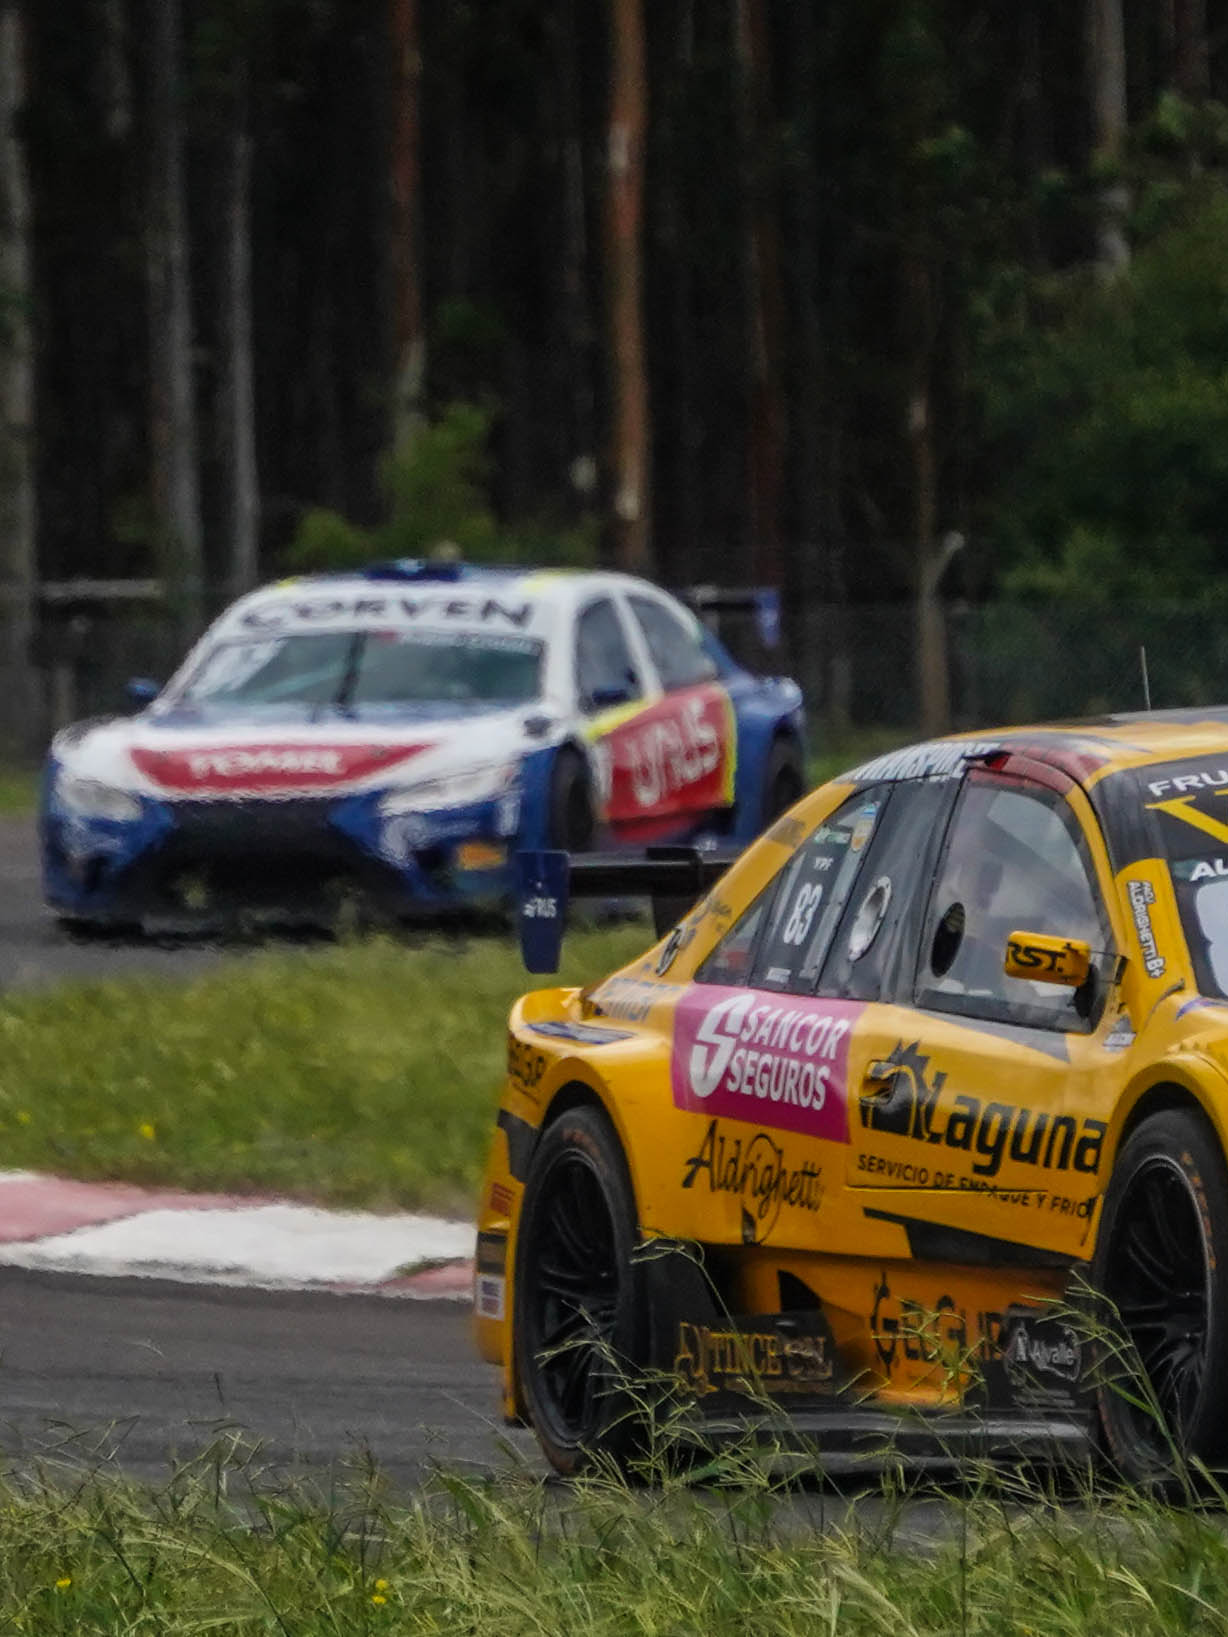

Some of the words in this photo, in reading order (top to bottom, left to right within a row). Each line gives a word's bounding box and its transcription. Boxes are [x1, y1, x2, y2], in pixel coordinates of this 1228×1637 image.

[240, 598, 536, 628] CORVEN
[783, 882, 823, 945] 83
[740, 1004, 850, 1060] SANCOR
[727, 1048, 831, 1111] SEGUROS
[921, 1071, 1108, 1177] Laguna
[858, 1154, 929, 1185] SERVICIO
[934, 1172, 954, 1189] DE
[1037, 1195, 1049, 1208] Y
